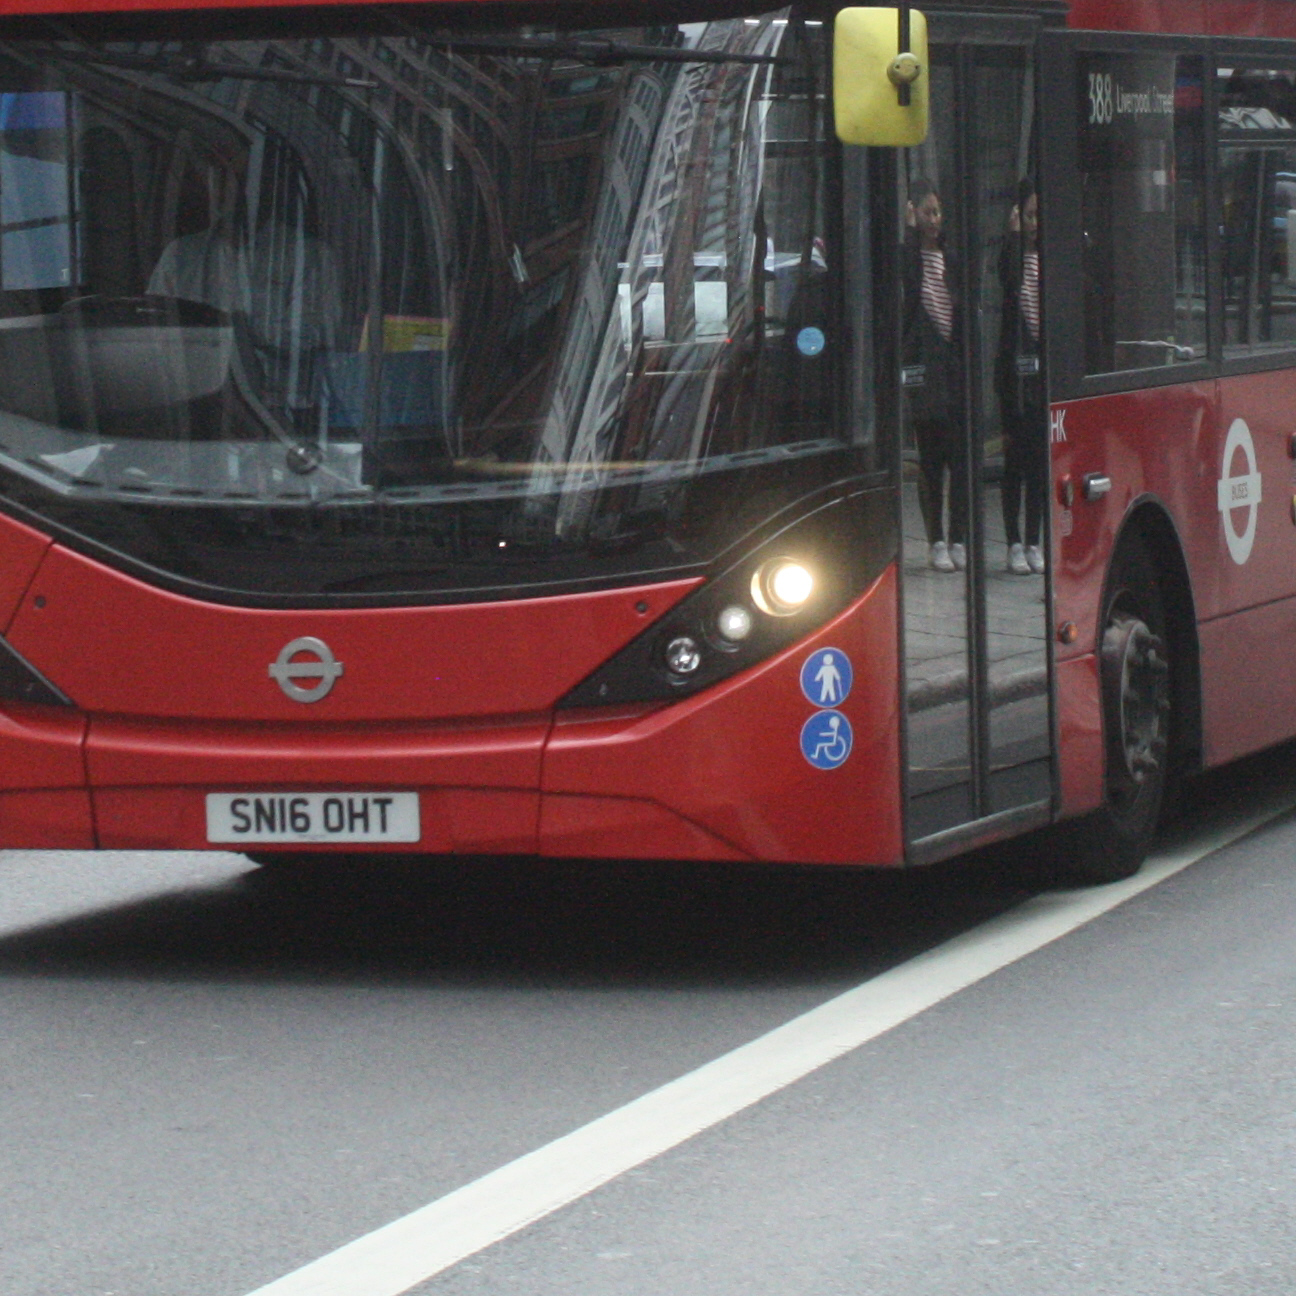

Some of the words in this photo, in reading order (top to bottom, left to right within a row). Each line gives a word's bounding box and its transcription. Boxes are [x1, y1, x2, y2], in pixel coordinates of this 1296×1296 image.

[1088, 73, 1113, 124] 388
[1116, 84, 1152, 122] Liverpool
[1050, 409, 1067, 443] HK
[230, 797, 310, 834] SN16
[323, 797, 394, 833] OHT
